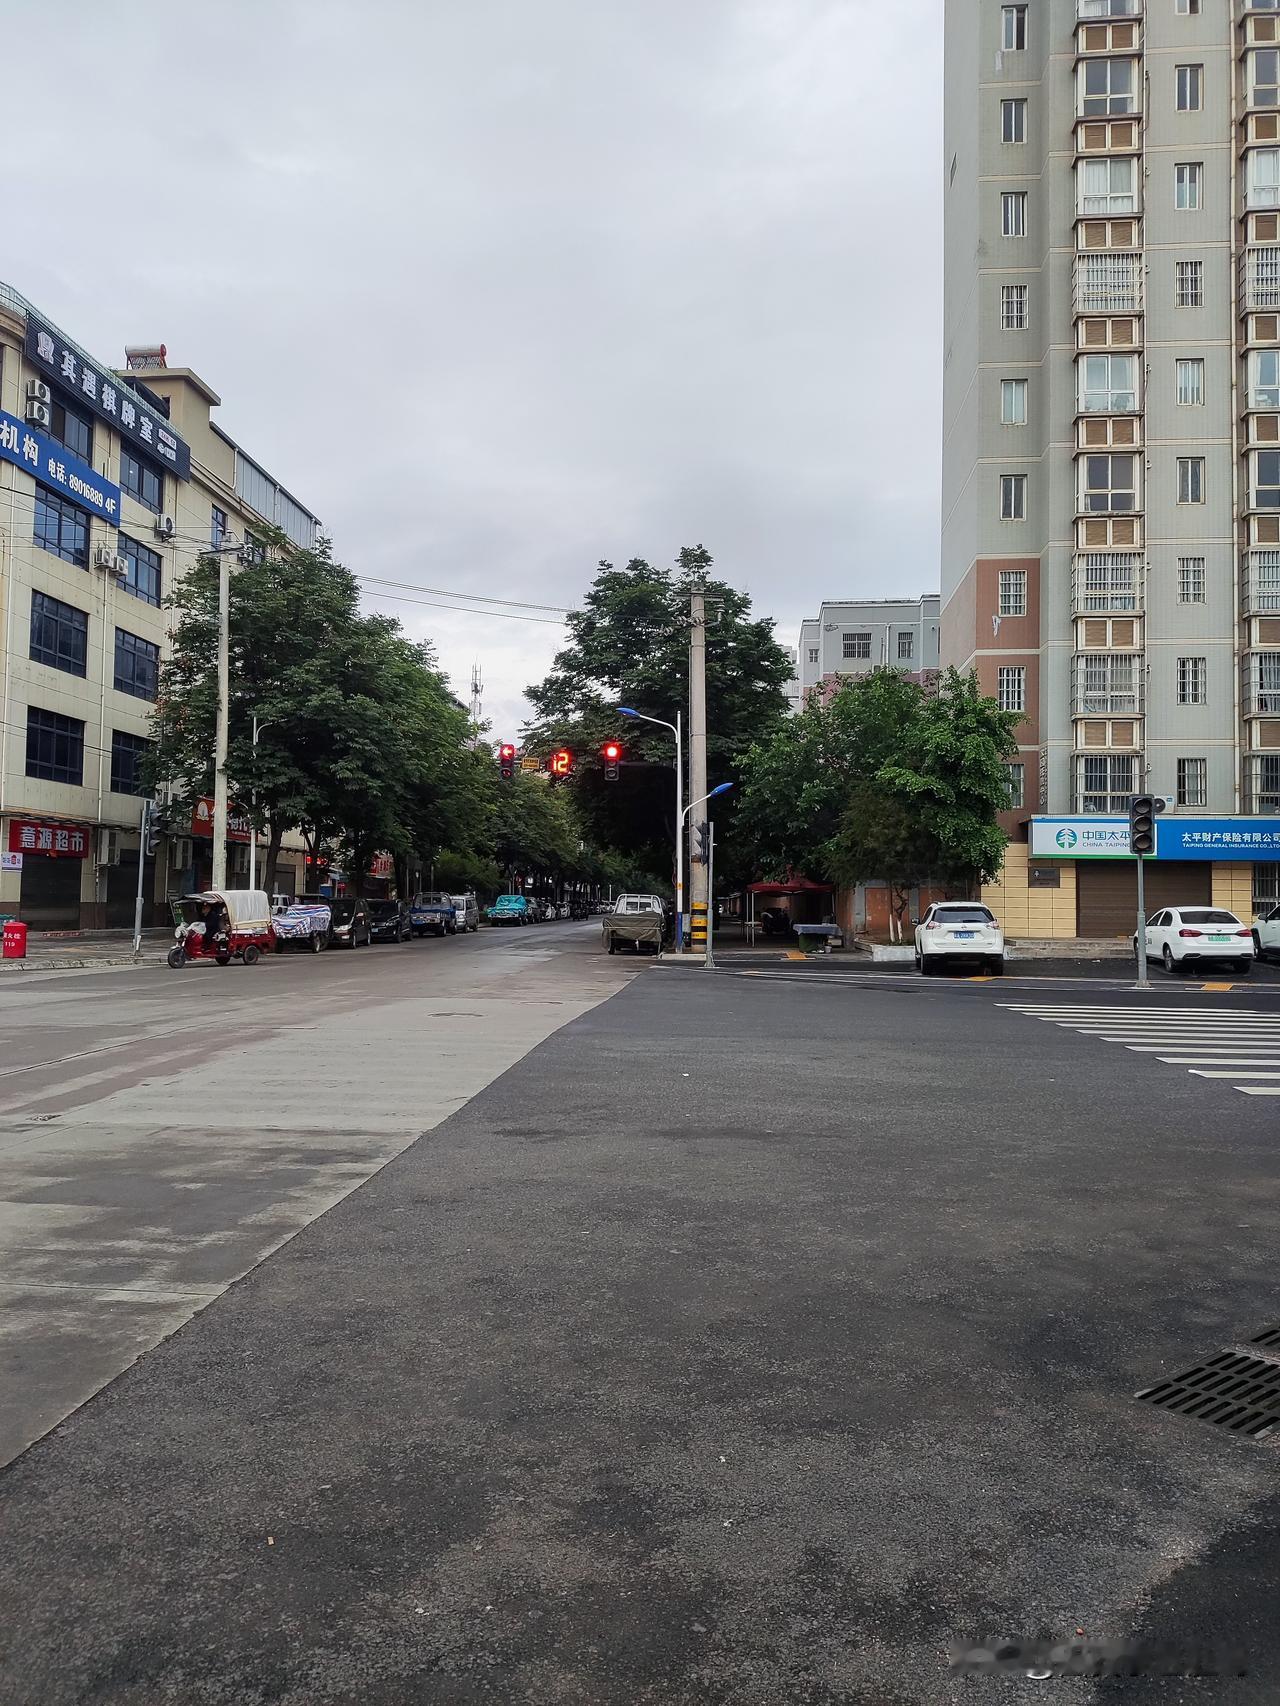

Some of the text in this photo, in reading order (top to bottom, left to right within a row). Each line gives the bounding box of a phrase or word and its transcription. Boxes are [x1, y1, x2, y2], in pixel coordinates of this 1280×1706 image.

[0, 420, 39, 467] 机构
[48, 458, 116, 514] 电话: 89016889 4F
[552, 752, 569, 772] 12
[1083, 831, 1130, 840] 中国太平
[1182, 832, 1280, 843] 太平财产保险有限公司
